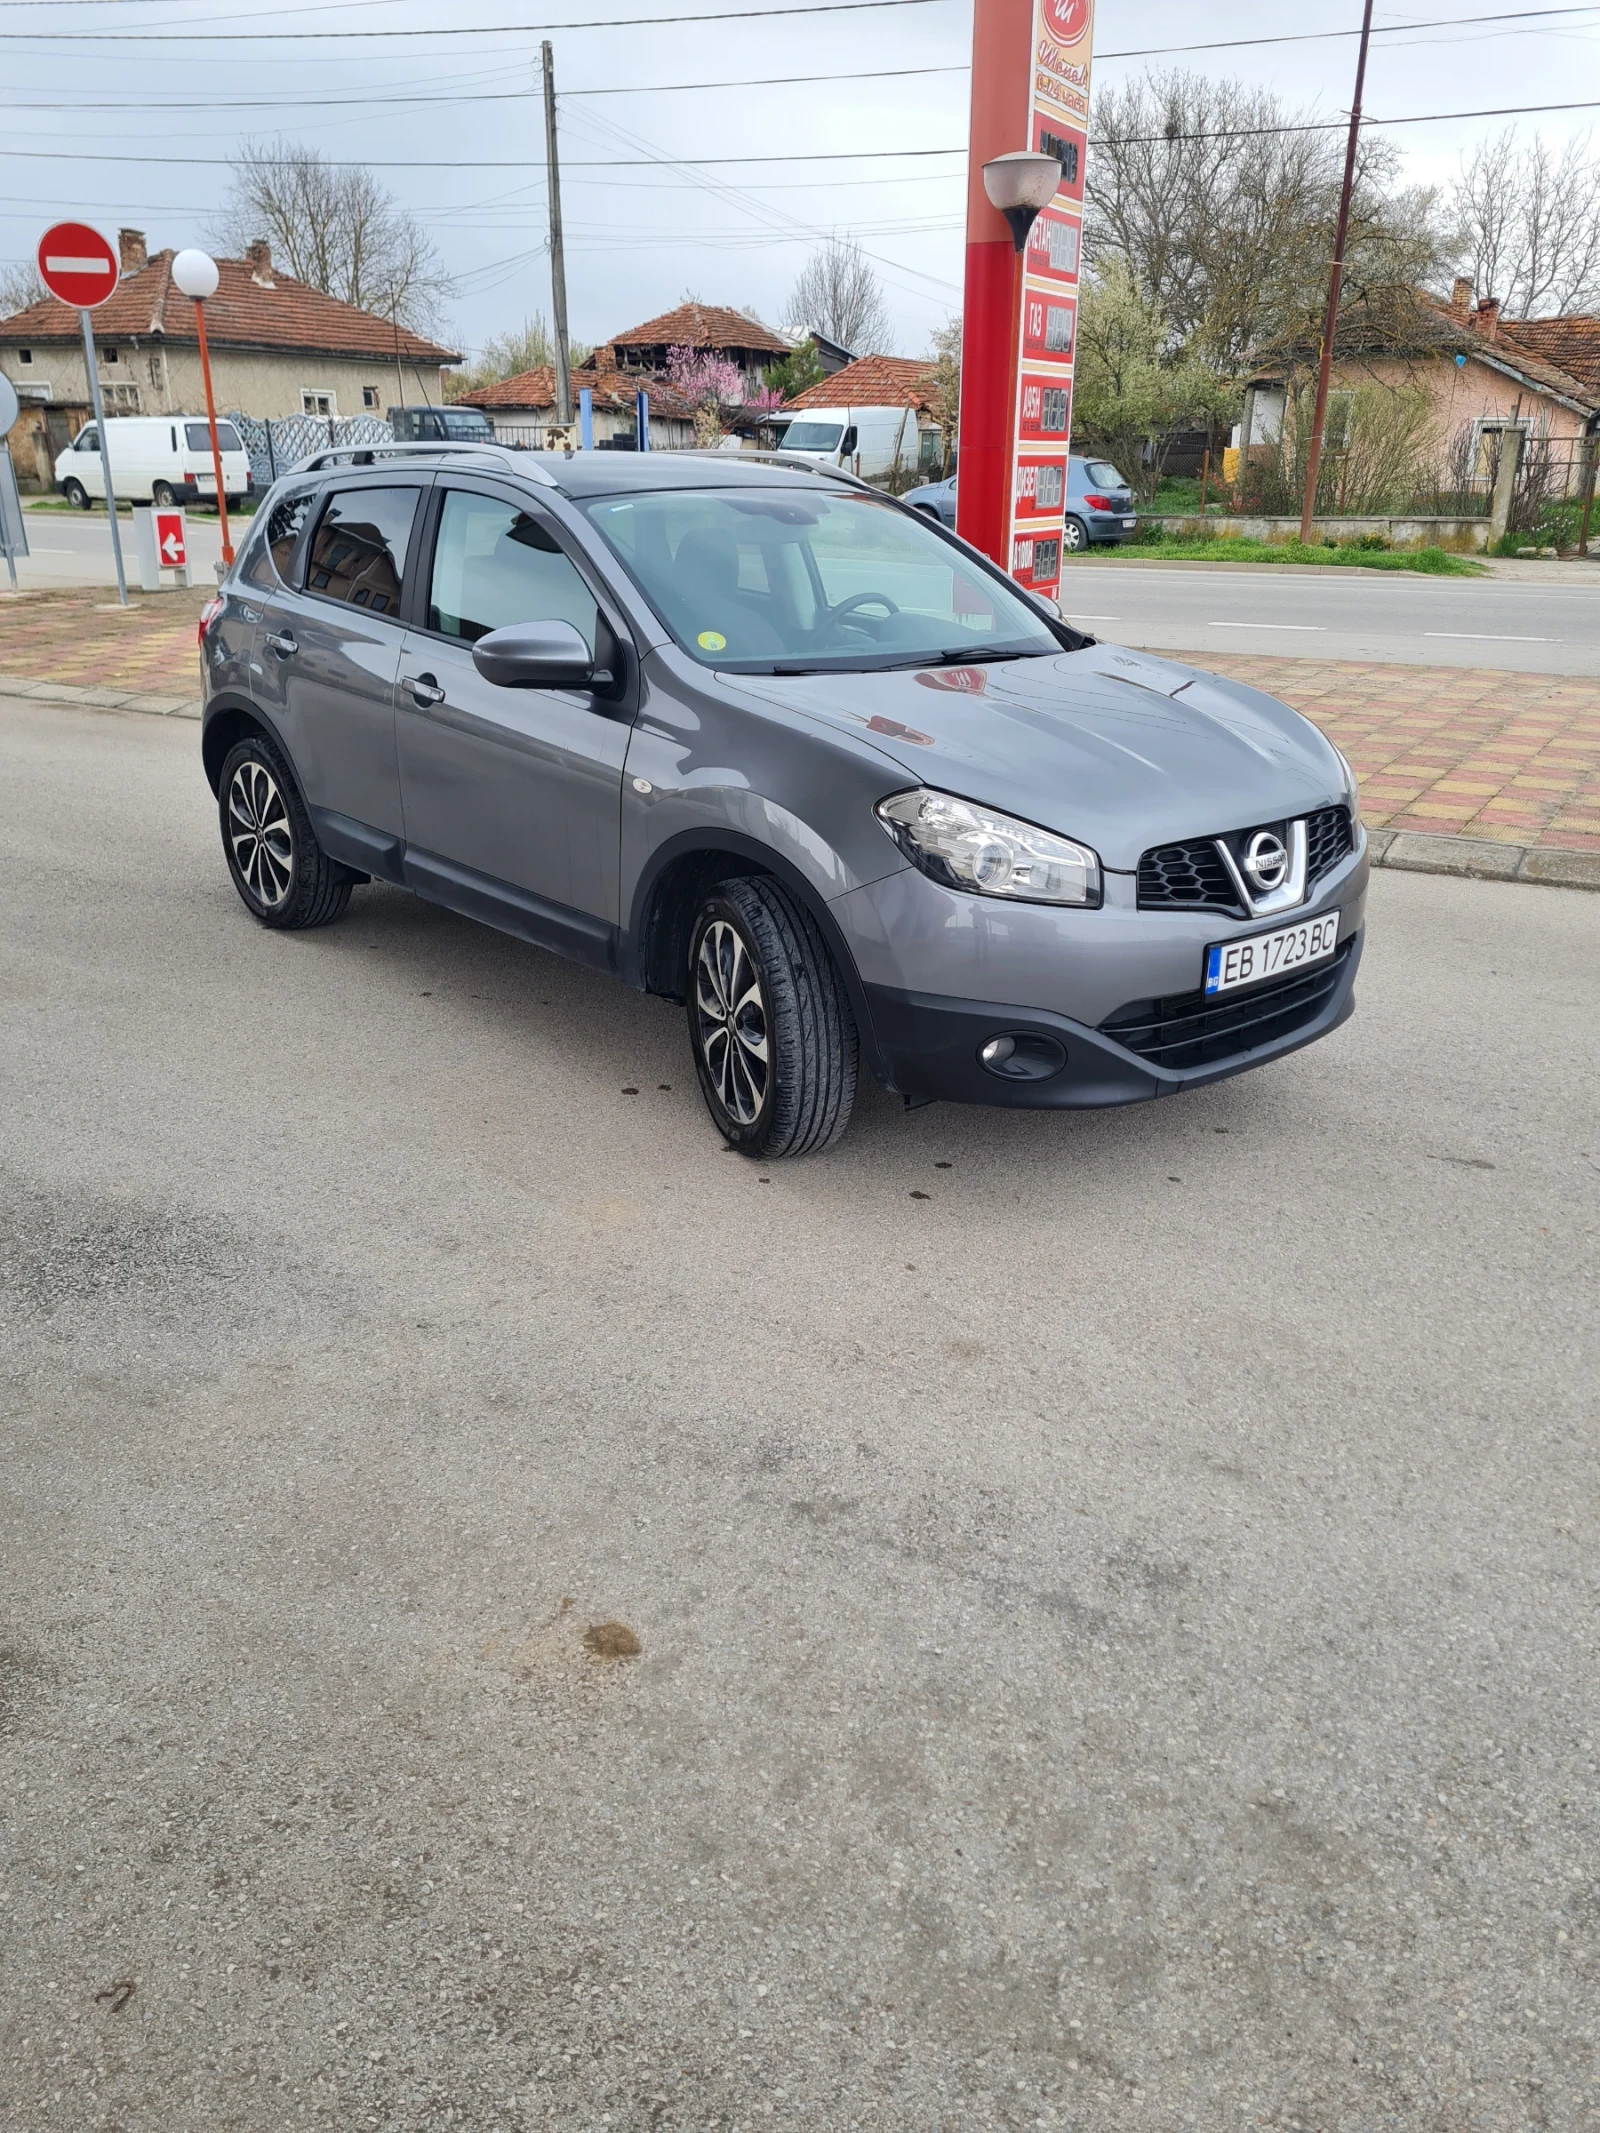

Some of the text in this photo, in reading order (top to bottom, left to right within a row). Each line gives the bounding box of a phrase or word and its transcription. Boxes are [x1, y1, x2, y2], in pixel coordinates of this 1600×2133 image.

[1029, 302, 1042, 337] ГАЗ
[1223, 918, 1336, 985] EB 1723 BC
[1206, 976, 1219, 988] BG
